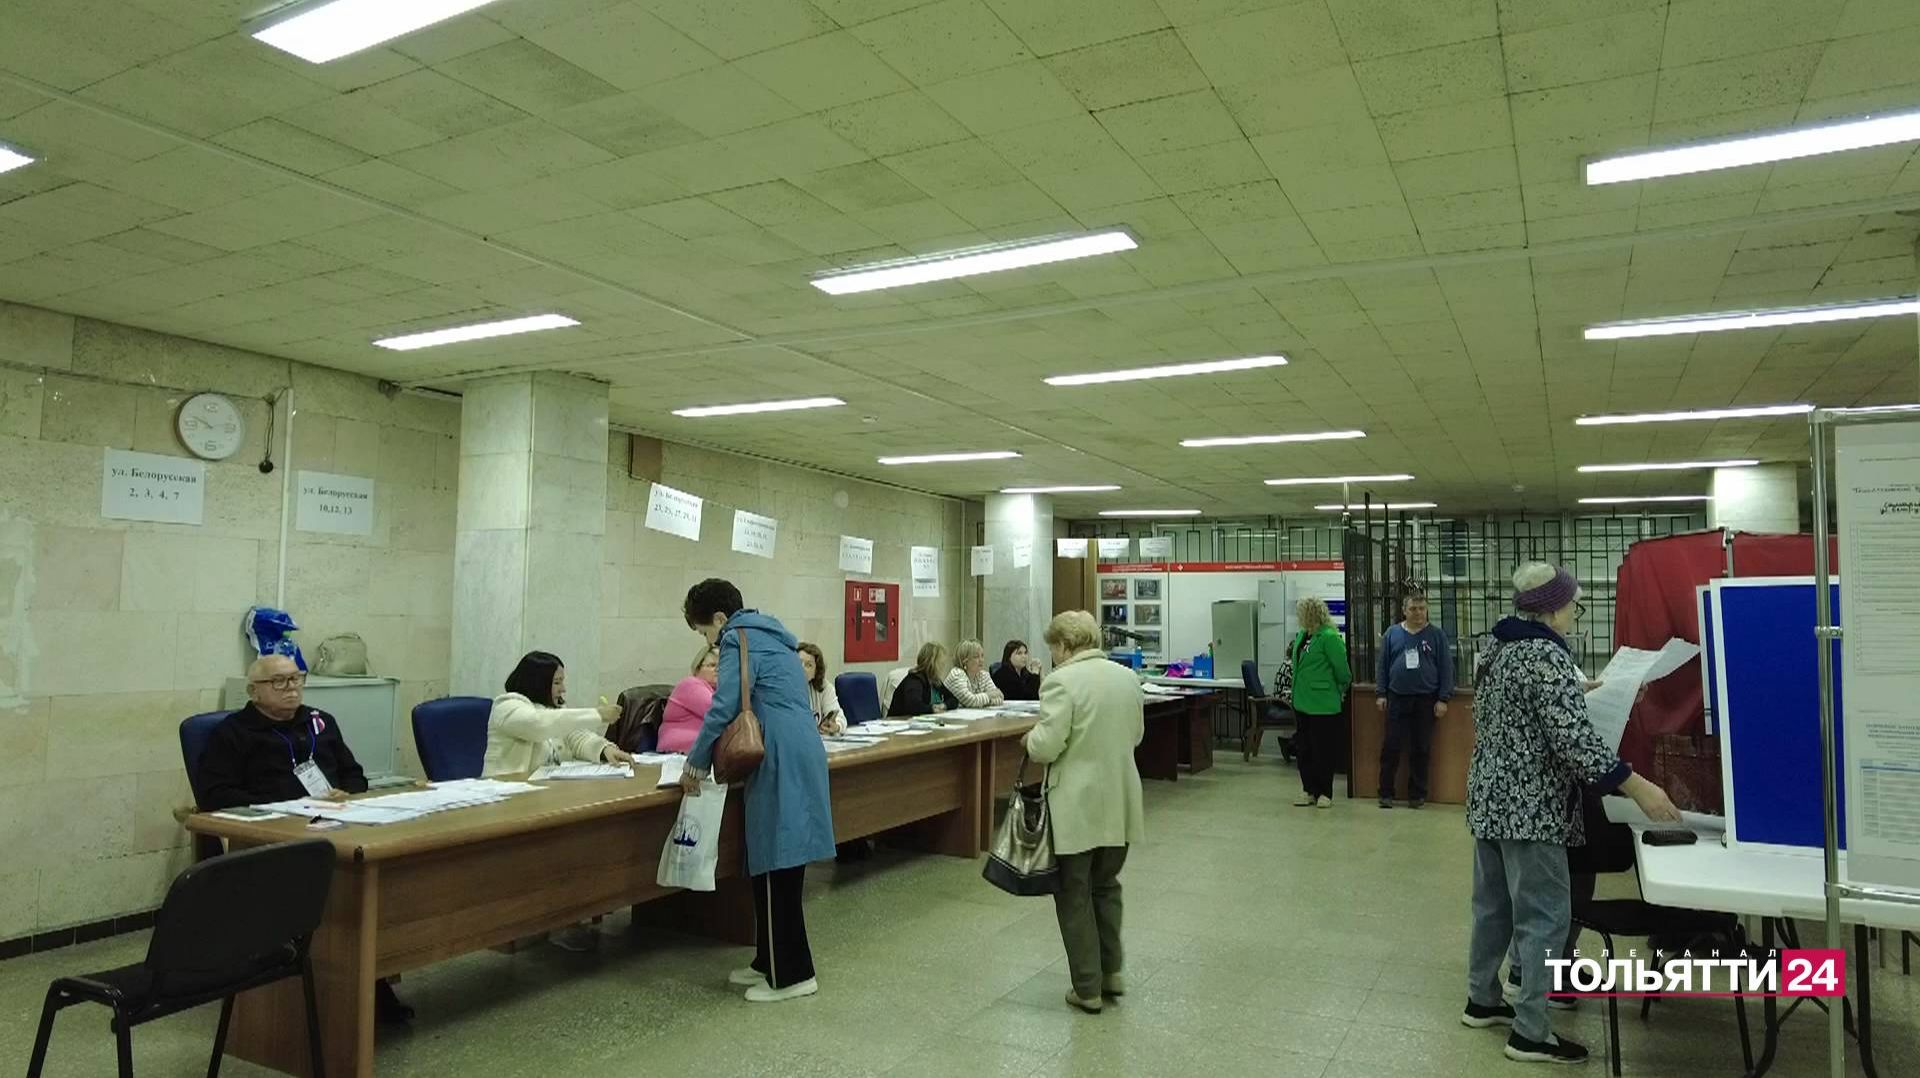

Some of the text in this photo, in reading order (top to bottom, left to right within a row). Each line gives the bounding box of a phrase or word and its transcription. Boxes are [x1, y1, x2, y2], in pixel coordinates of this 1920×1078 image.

[111, 467, 197, 483] ул. Белорусская
[129, 487, 139, 498] 2,
[144, 488, 154, 499] 3,
[173, 491, 180, 500] 7
